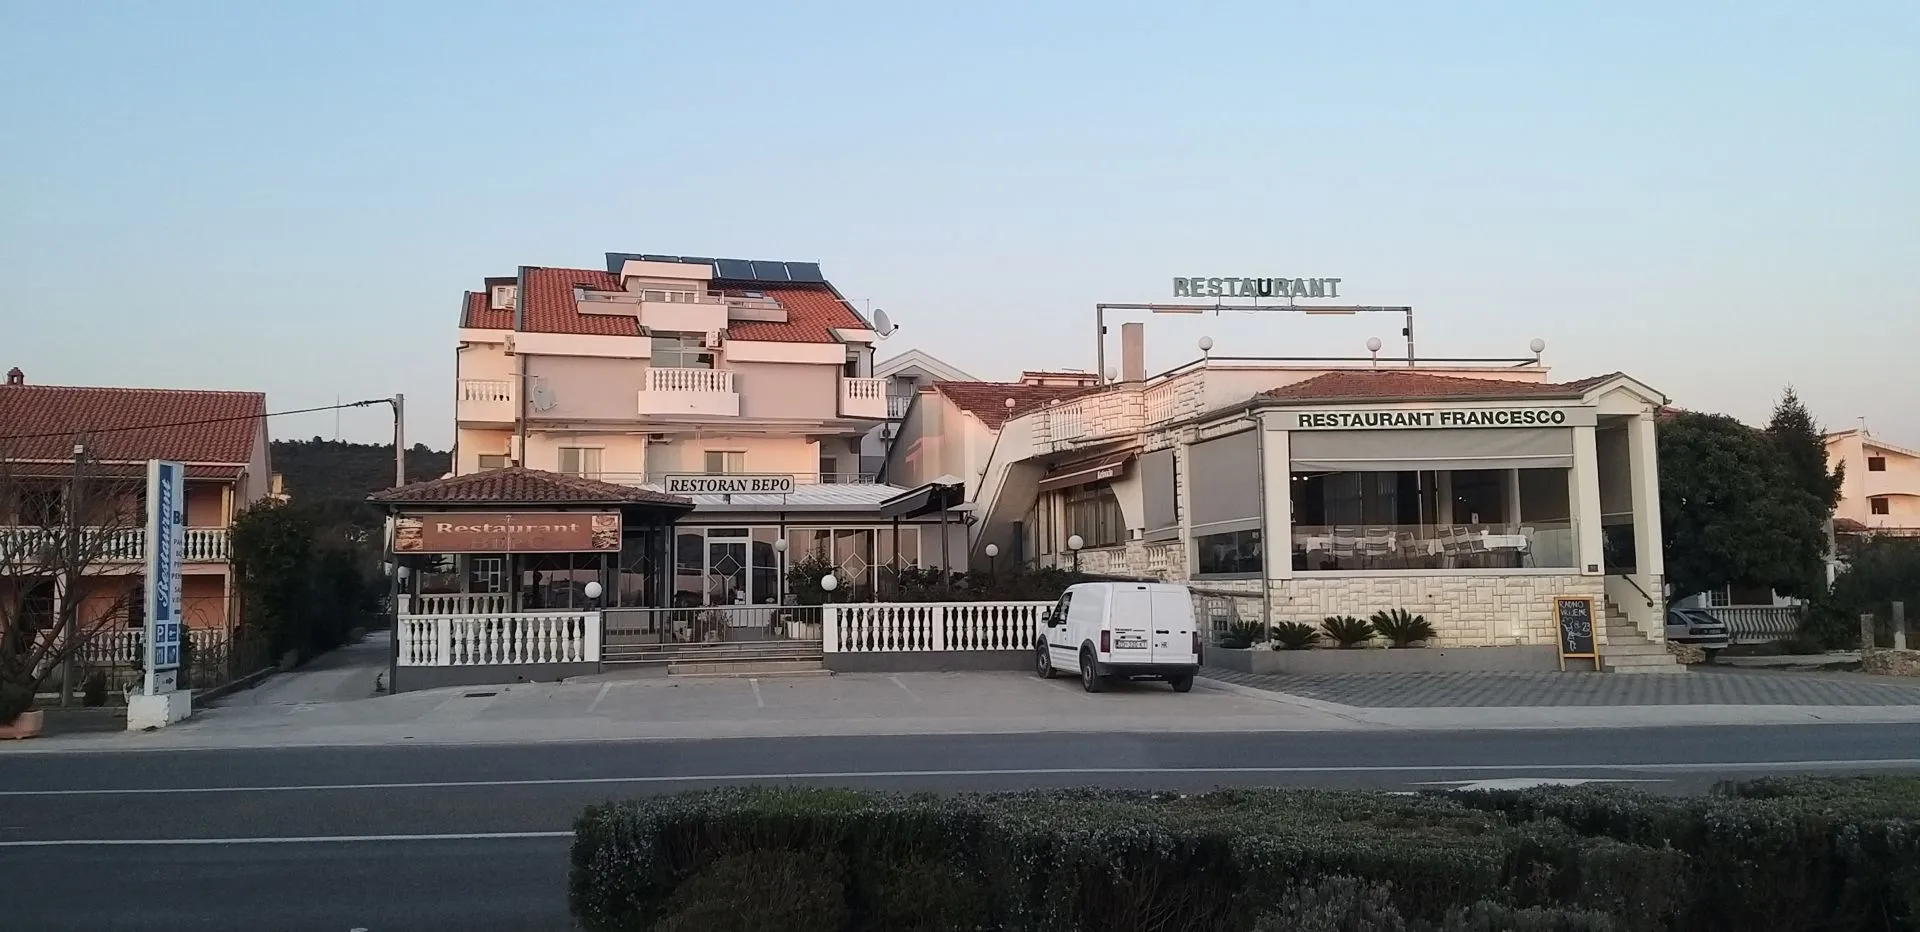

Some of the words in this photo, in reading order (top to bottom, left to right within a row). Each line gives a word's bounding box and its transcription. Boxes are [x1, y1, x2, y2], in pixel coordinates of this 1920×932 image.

[1173, 277, 1342, 298] RESTAURANT
[1298, 412, 1435, 428] RESTAURANT
[1440, 410, 1566, 426] FRANCESCO
[669, 479, 747, 492] RESTORAN
[751, 478, 790, 491] BEPO
[436, 522, 580, 534] Restaurant
[157, 477, 171, 608] Restaurant
